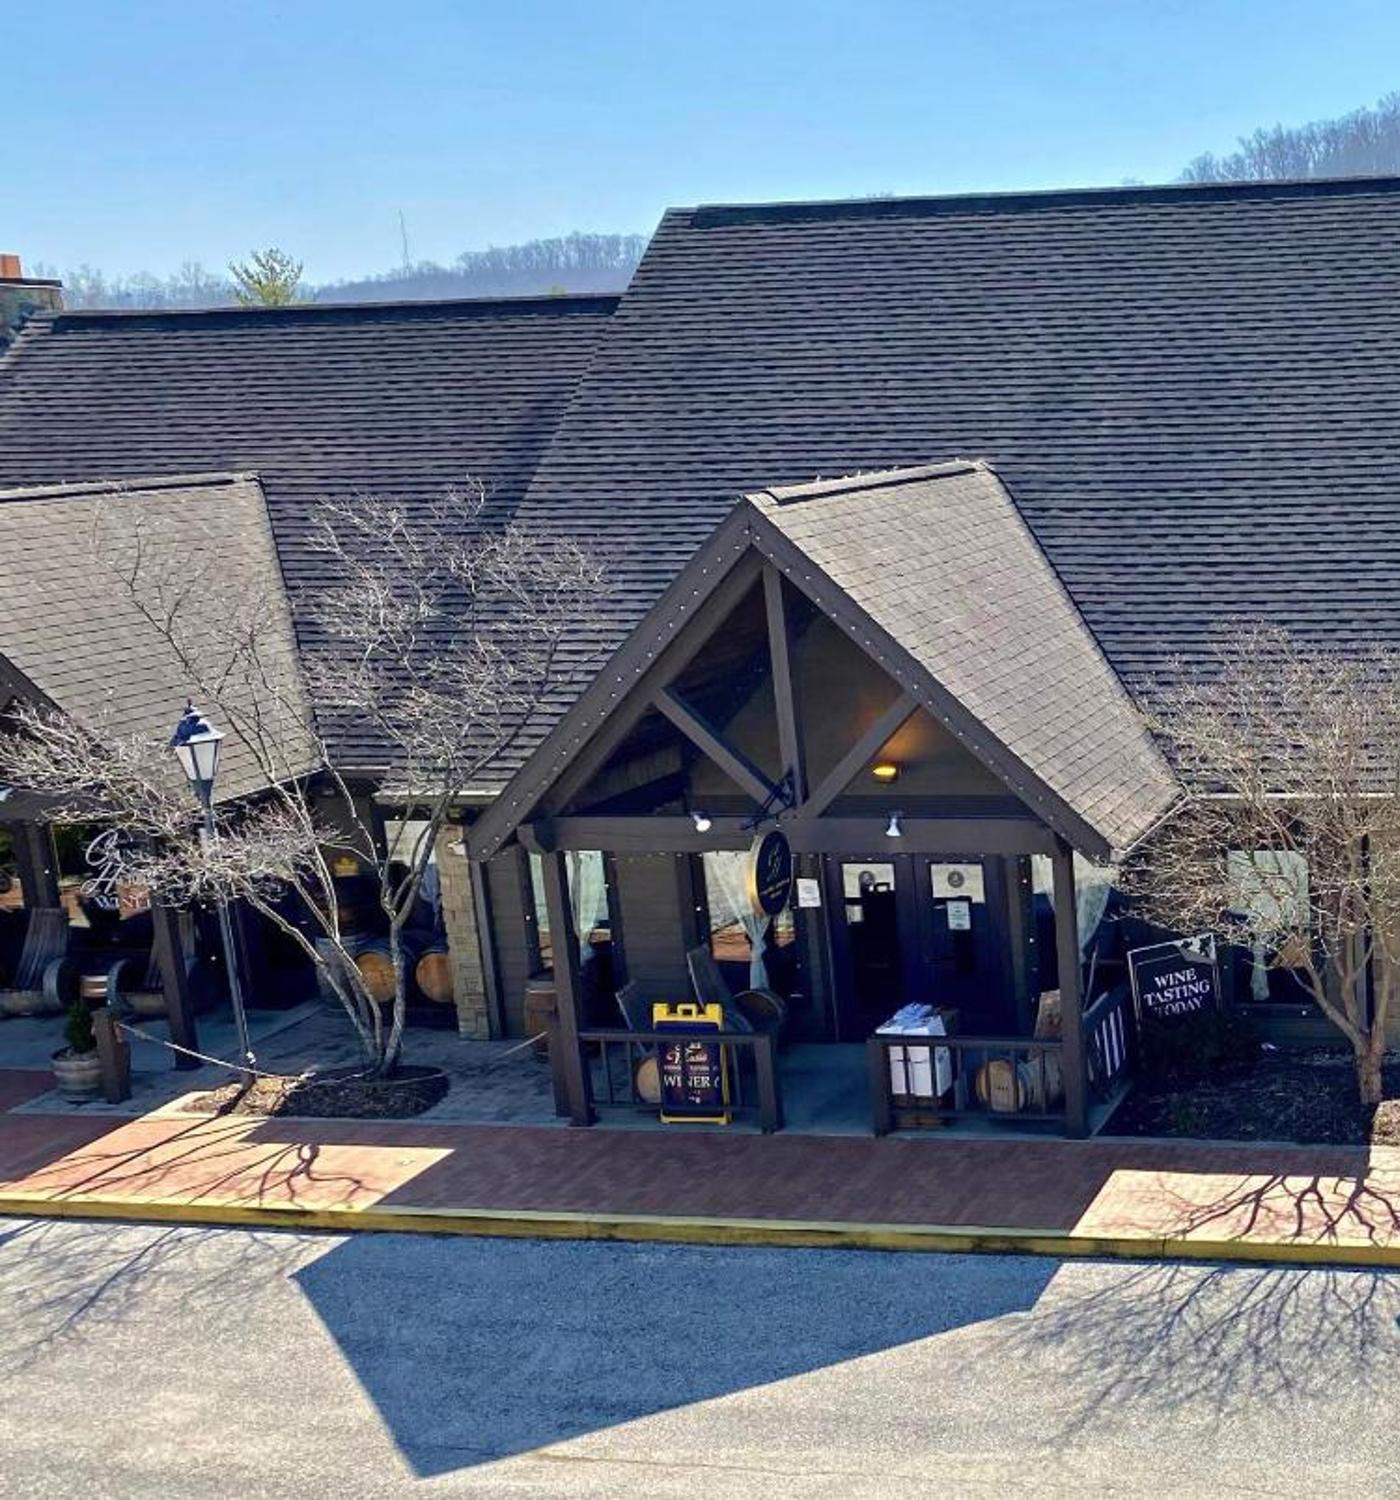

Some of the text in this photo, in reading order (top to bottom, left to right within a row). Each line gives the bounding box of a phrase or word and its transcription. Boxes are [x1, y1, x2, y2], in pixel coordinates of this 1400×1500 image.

[1154, 968, 1197, 989] WINE
[1143, 979, 1211, 1007] TASTING
[1153, 996, 1204, 1016] TODAY
